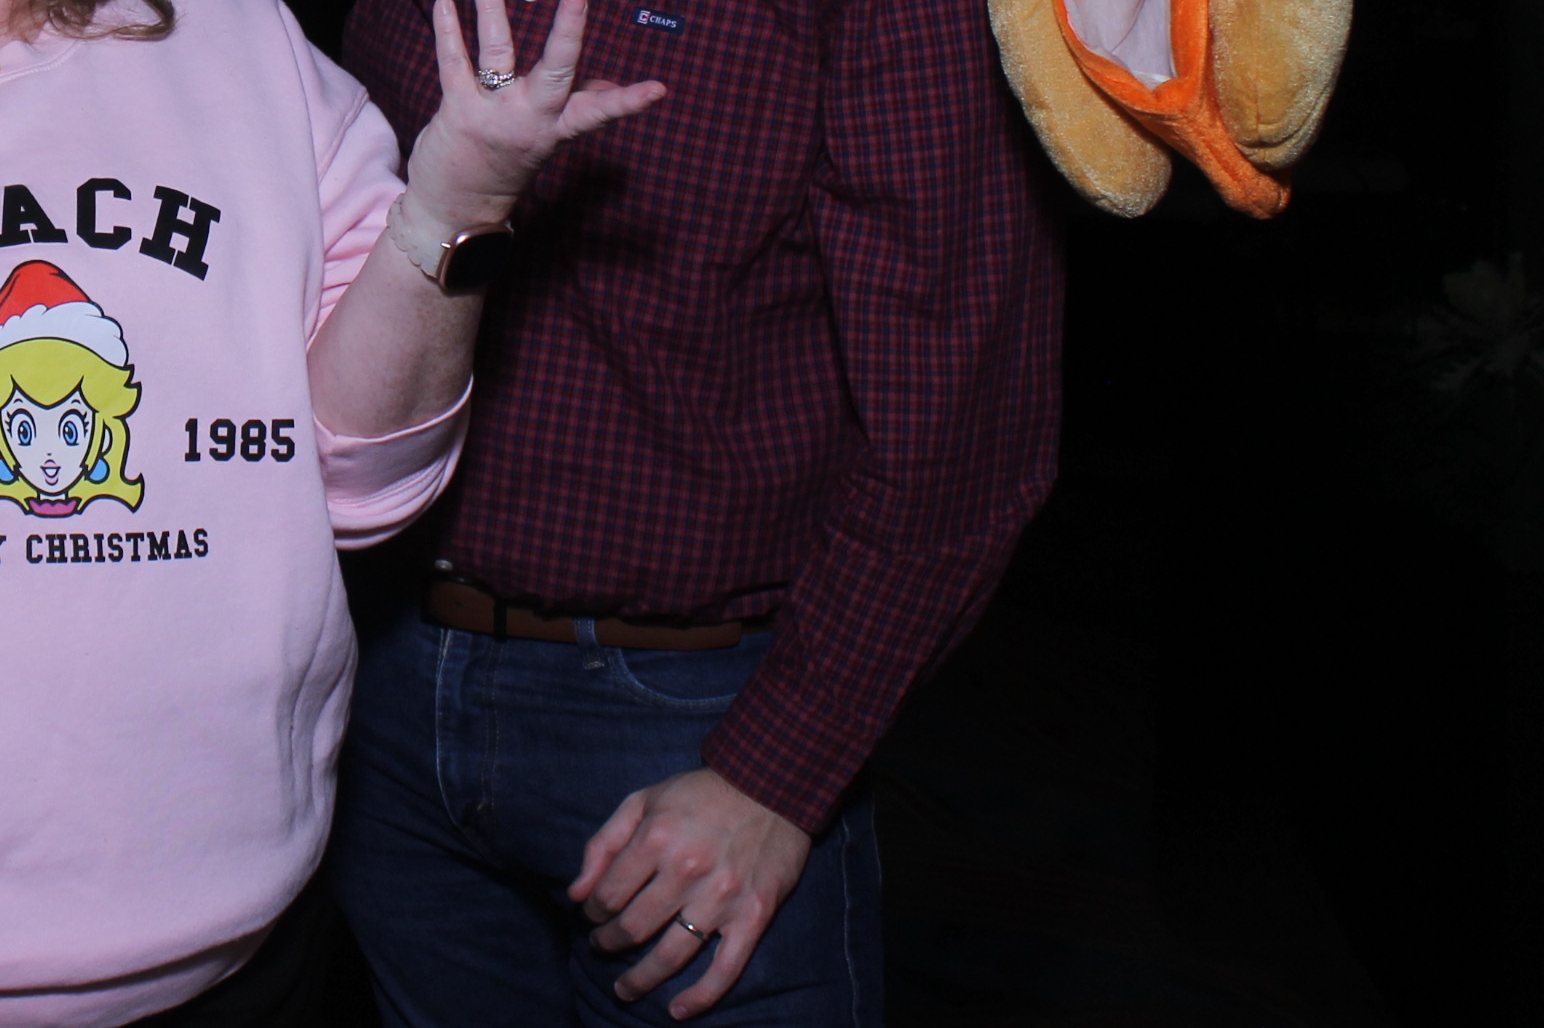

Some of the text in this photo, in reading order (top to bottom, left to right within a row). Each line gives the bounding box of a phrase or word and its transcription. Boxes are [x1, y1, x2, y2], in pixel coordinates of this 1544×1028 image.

[649, 15, 677, 28] CHAPS
[184, 417, 296, 463] 1985
[25, 528, 209, 565] CHRISTMAS
